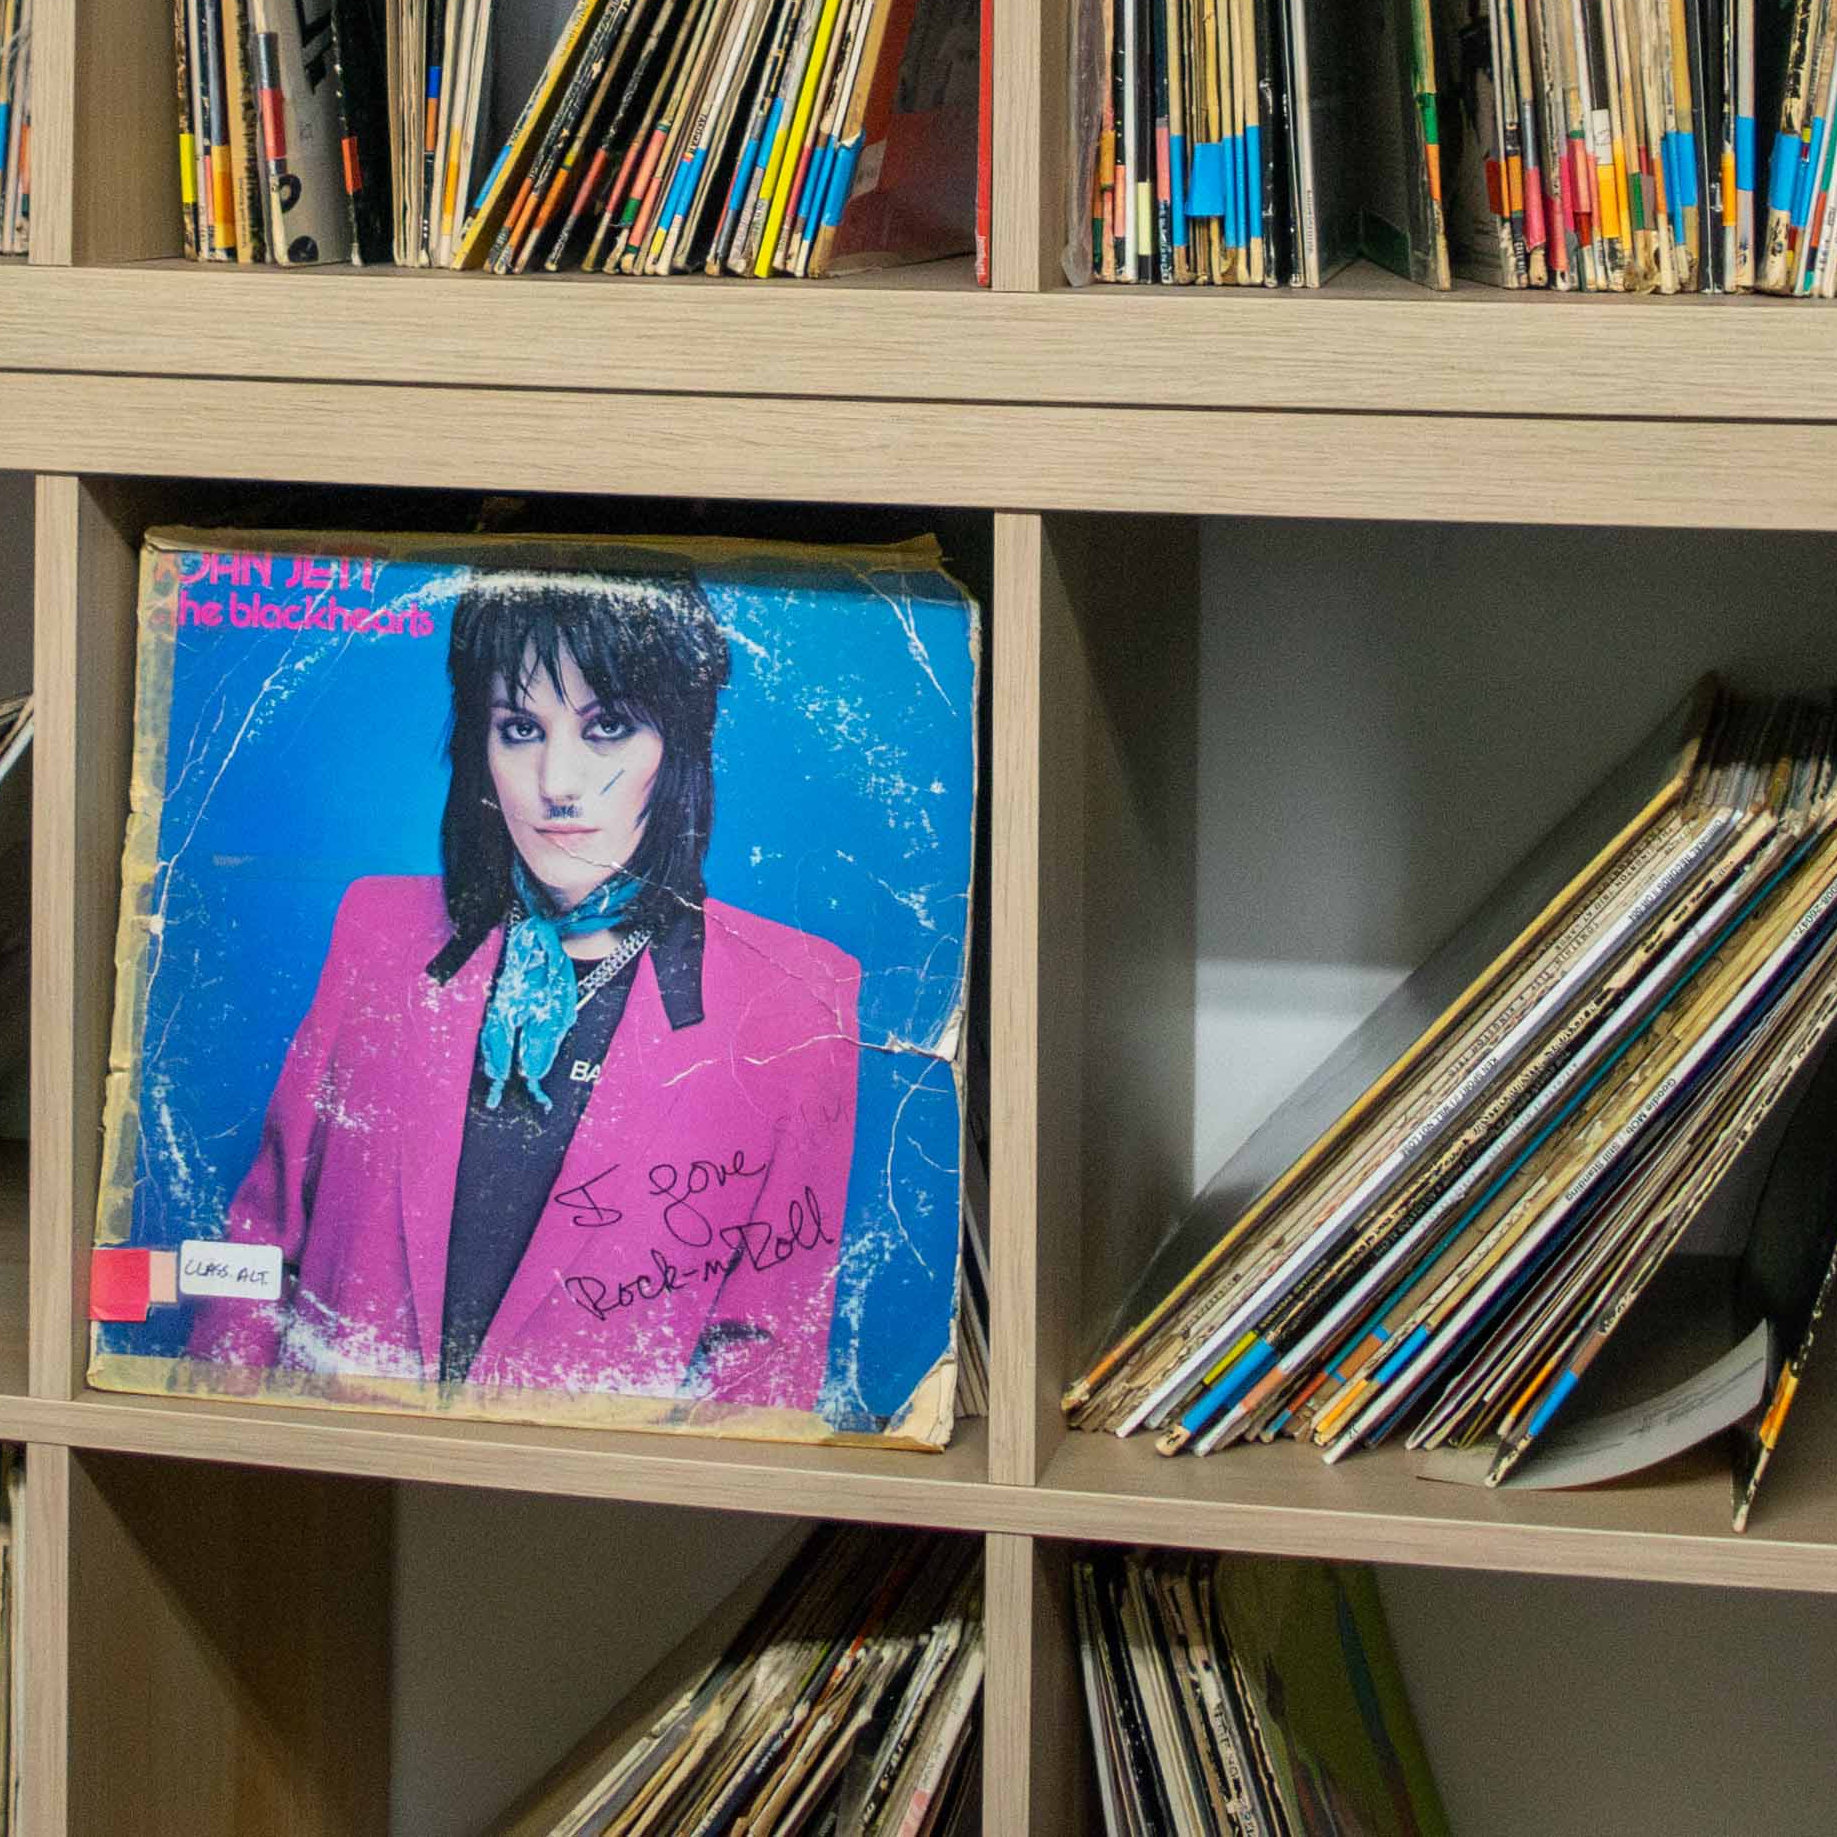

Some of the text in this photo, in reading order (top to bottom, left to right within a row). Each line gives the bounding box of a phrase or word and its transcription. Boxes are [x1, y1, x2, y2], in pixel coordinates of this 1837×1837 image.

[229, 590, 435, 639] blackhearts
[1654, 850, 1693, 892] RECORDS
[1478, 1054, 1498, 1076] KEN
[1643, 1075, 1677, 1113] Goodie
[1599, 1140, 1621, 1163] Still
[648, 1149, 767, 1248] Love
[1563, 1157, 1605, 1205] Standing
